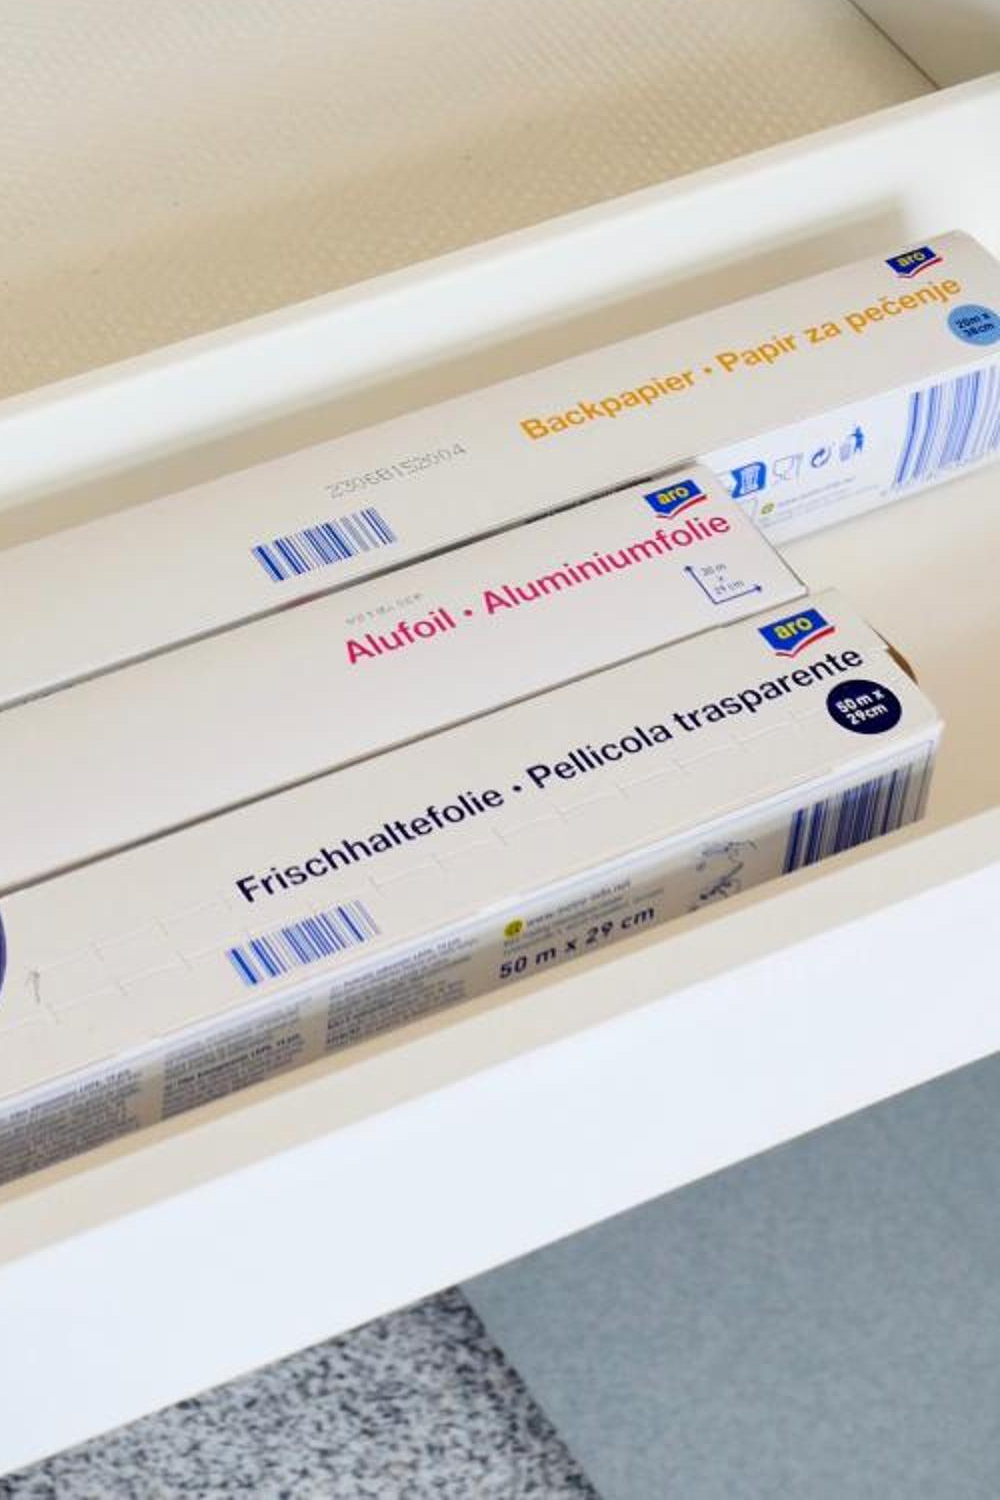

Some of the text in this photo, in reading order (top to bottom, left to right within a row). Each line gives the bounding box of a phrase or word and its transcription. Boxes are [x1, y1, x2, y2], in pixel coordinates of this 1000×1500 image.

[897, 251, 926, 267] aro
[520, 279, 962, 440] Backpapier Papir za pečenje
[657, 486, 690, 505] aro
[344, 516, 732, 665] Alufoil Aluminiumfolie
[773, 616, 814, 640] aro
[845, 703, 889, 726] 29cm
[235, 650, 864, 904] Frischhaltefolie Pellicola trasparente
[499, 906, 655, 980] 50 m x 29 cm
